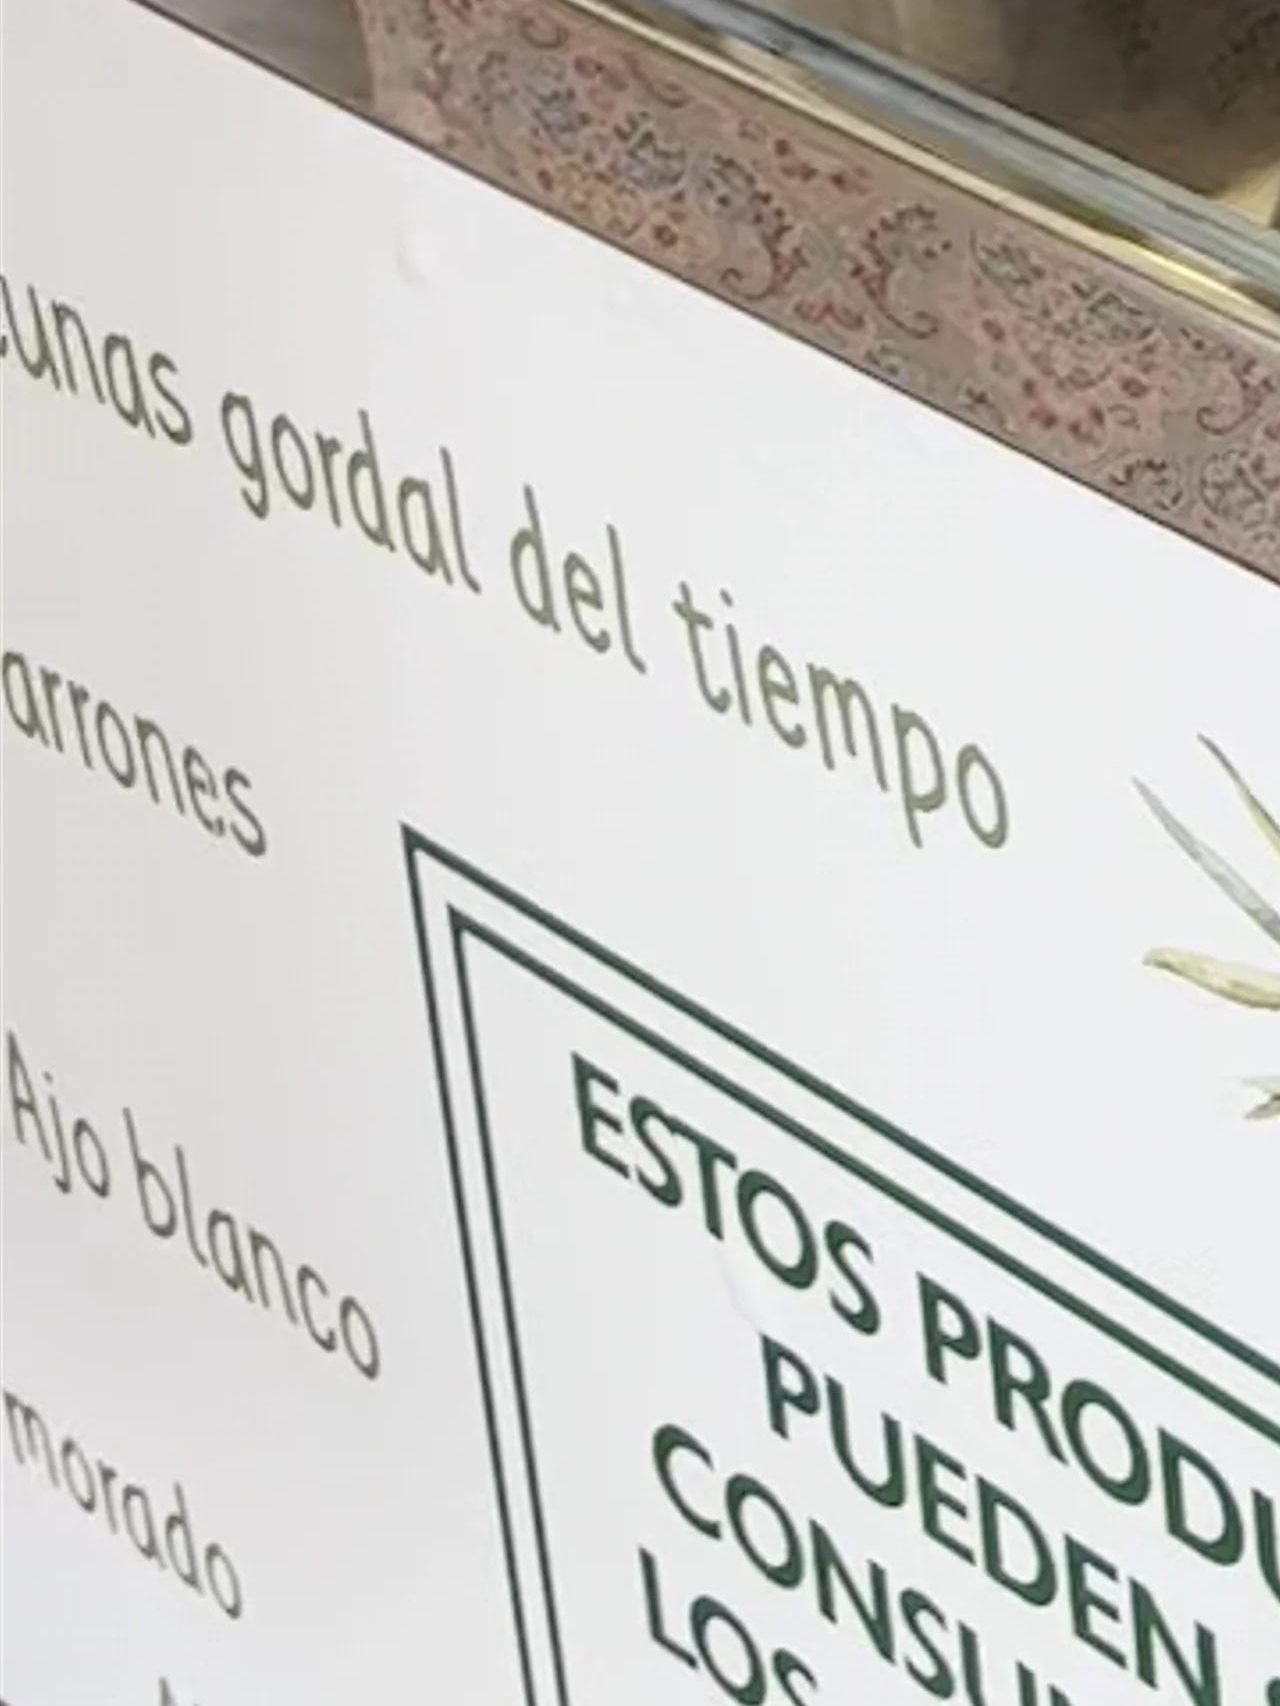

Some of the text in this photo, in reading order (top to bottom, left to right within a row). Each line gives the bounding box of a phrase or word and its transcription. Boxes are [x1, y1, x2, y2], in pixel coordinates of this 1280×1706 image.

[0, 271, 1010, 851] unas gordal del tiempo
[5, 1029, 382, 1382] Ajo blanco
[569, 1050, 883, 1338] ESTOS
[3, 1390, 243, 1621] morado
